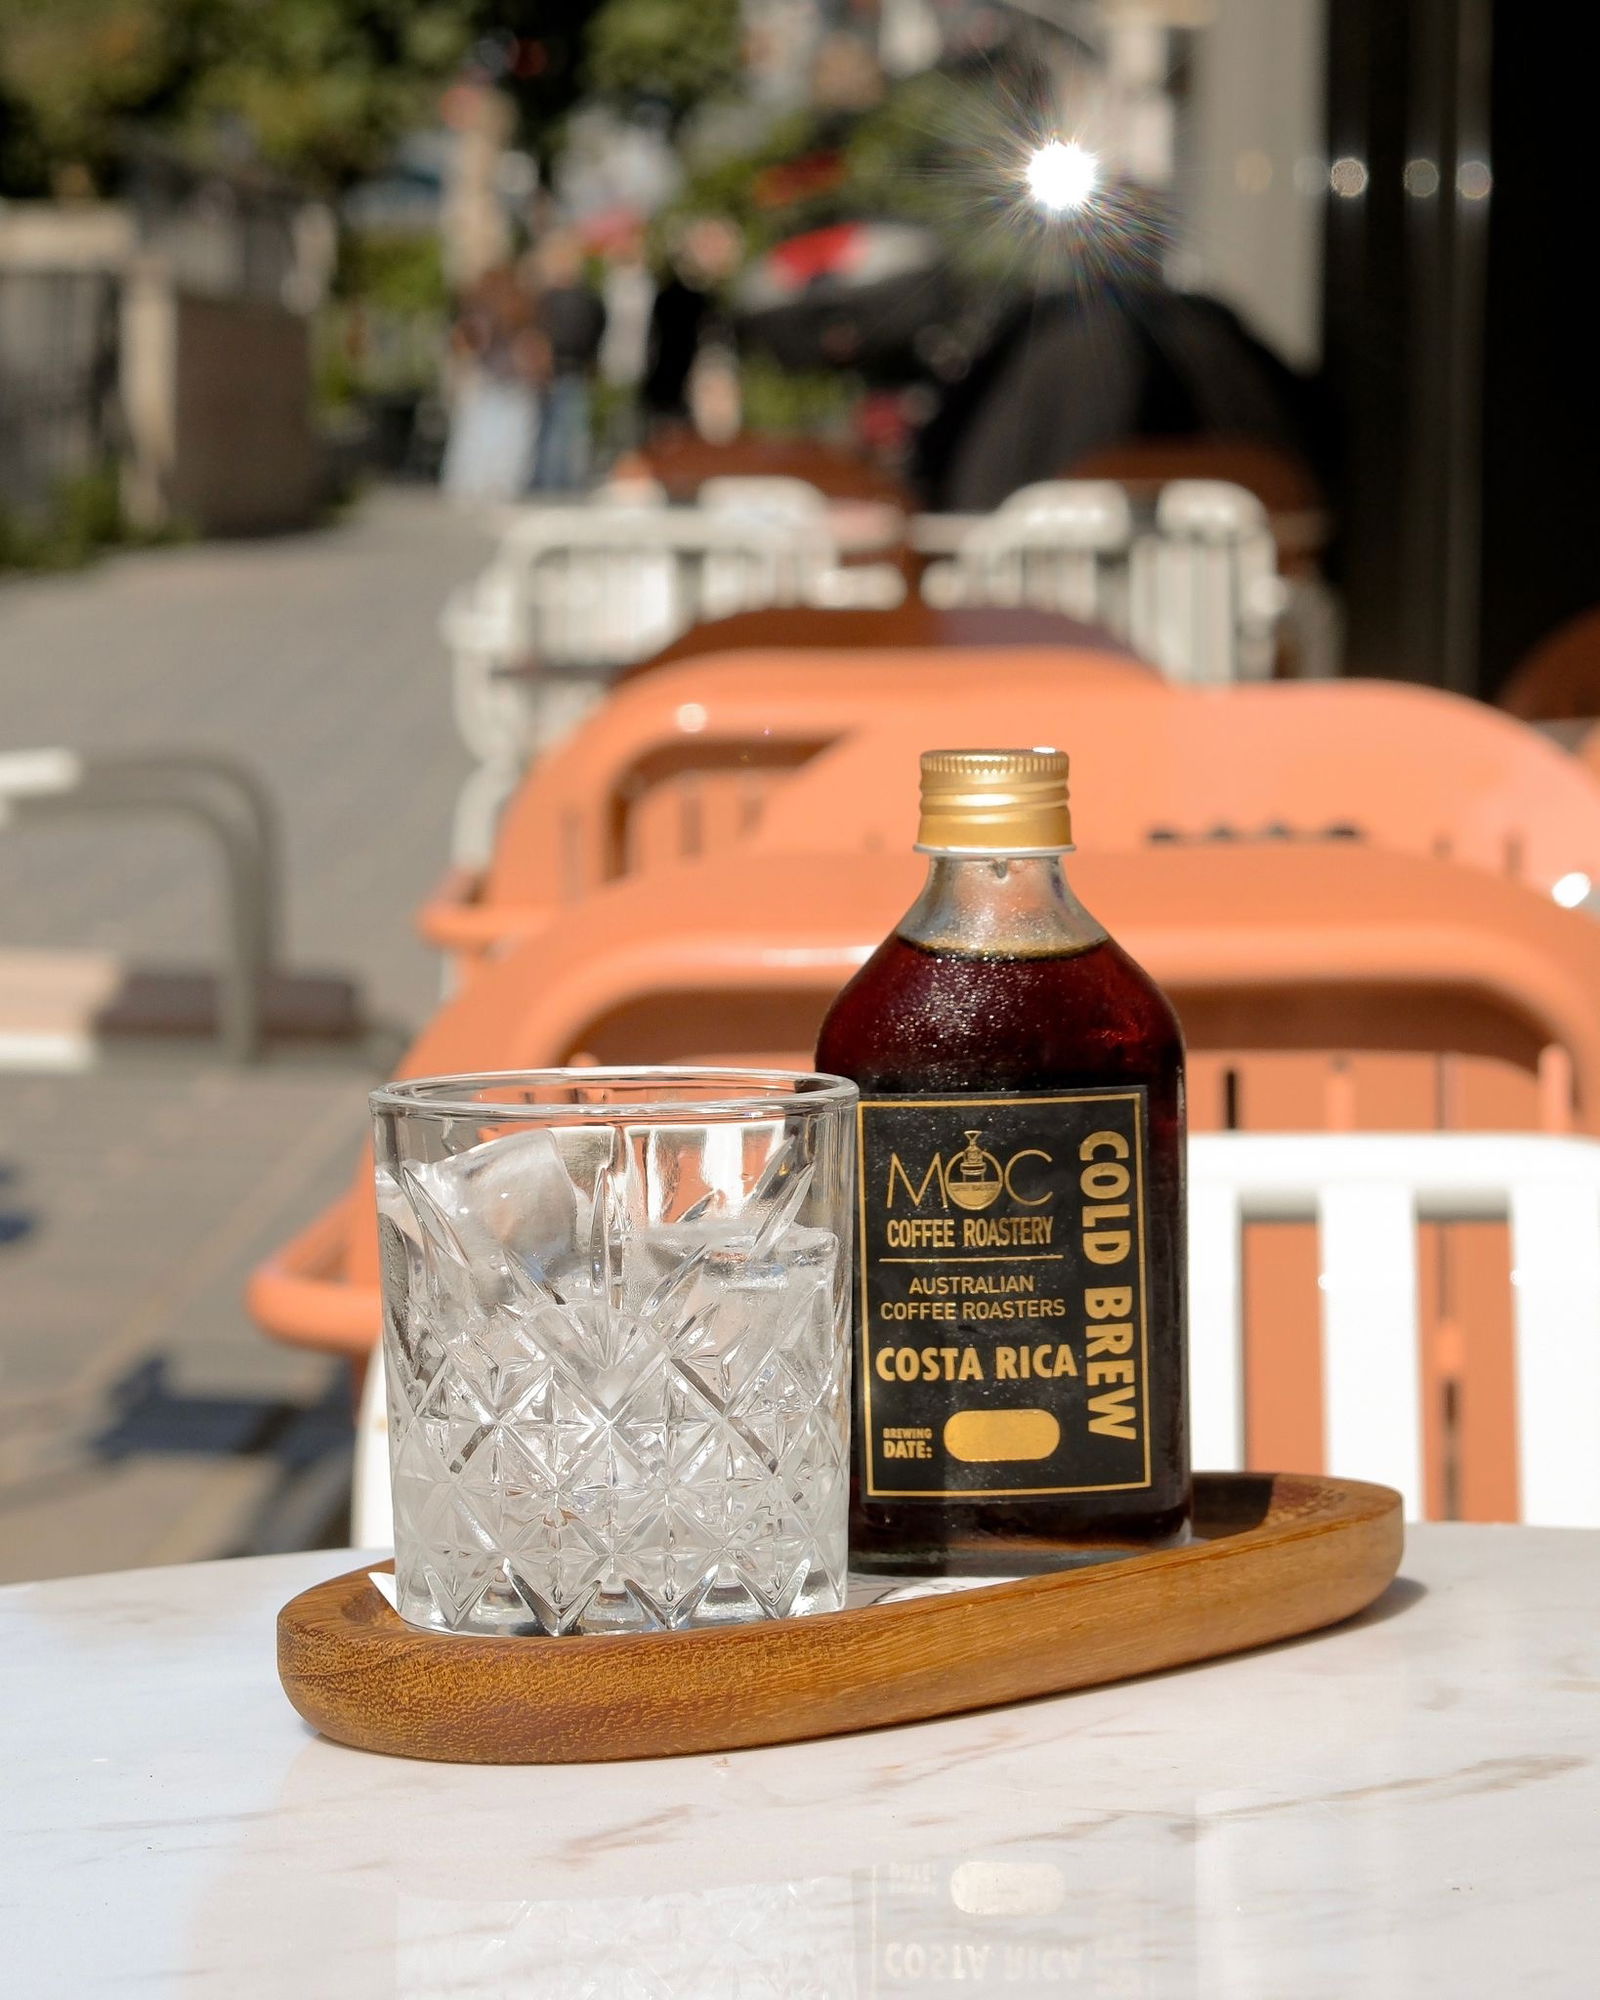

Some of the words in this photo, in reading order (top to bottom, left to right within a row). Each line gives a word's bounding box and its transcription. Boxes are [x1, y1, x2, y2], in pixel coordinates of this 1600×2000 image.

[886, 1148, 1054, 1211] MOC
[1079, 1130, 1131, 1266] COLD
[887, 1218, 956, 1248] COFFEE
[963, 1216, 1054, 1247] ROASTERY
[908, 1275, 1035, 1296] AUSTRALIAN
[880, 1301, 957, 1321] COFFEE
[962, 1298, 1066, 1319] ROASTERS
[875, 1346, 984, 1382] COSTA
[995, 1344, 1079, 1380] RICA
[1084, 1285, 1137, 1441] BREW
[883, 1427, 933, 1439] BREWING
[883, 1440, 933, 1459] DATE:
